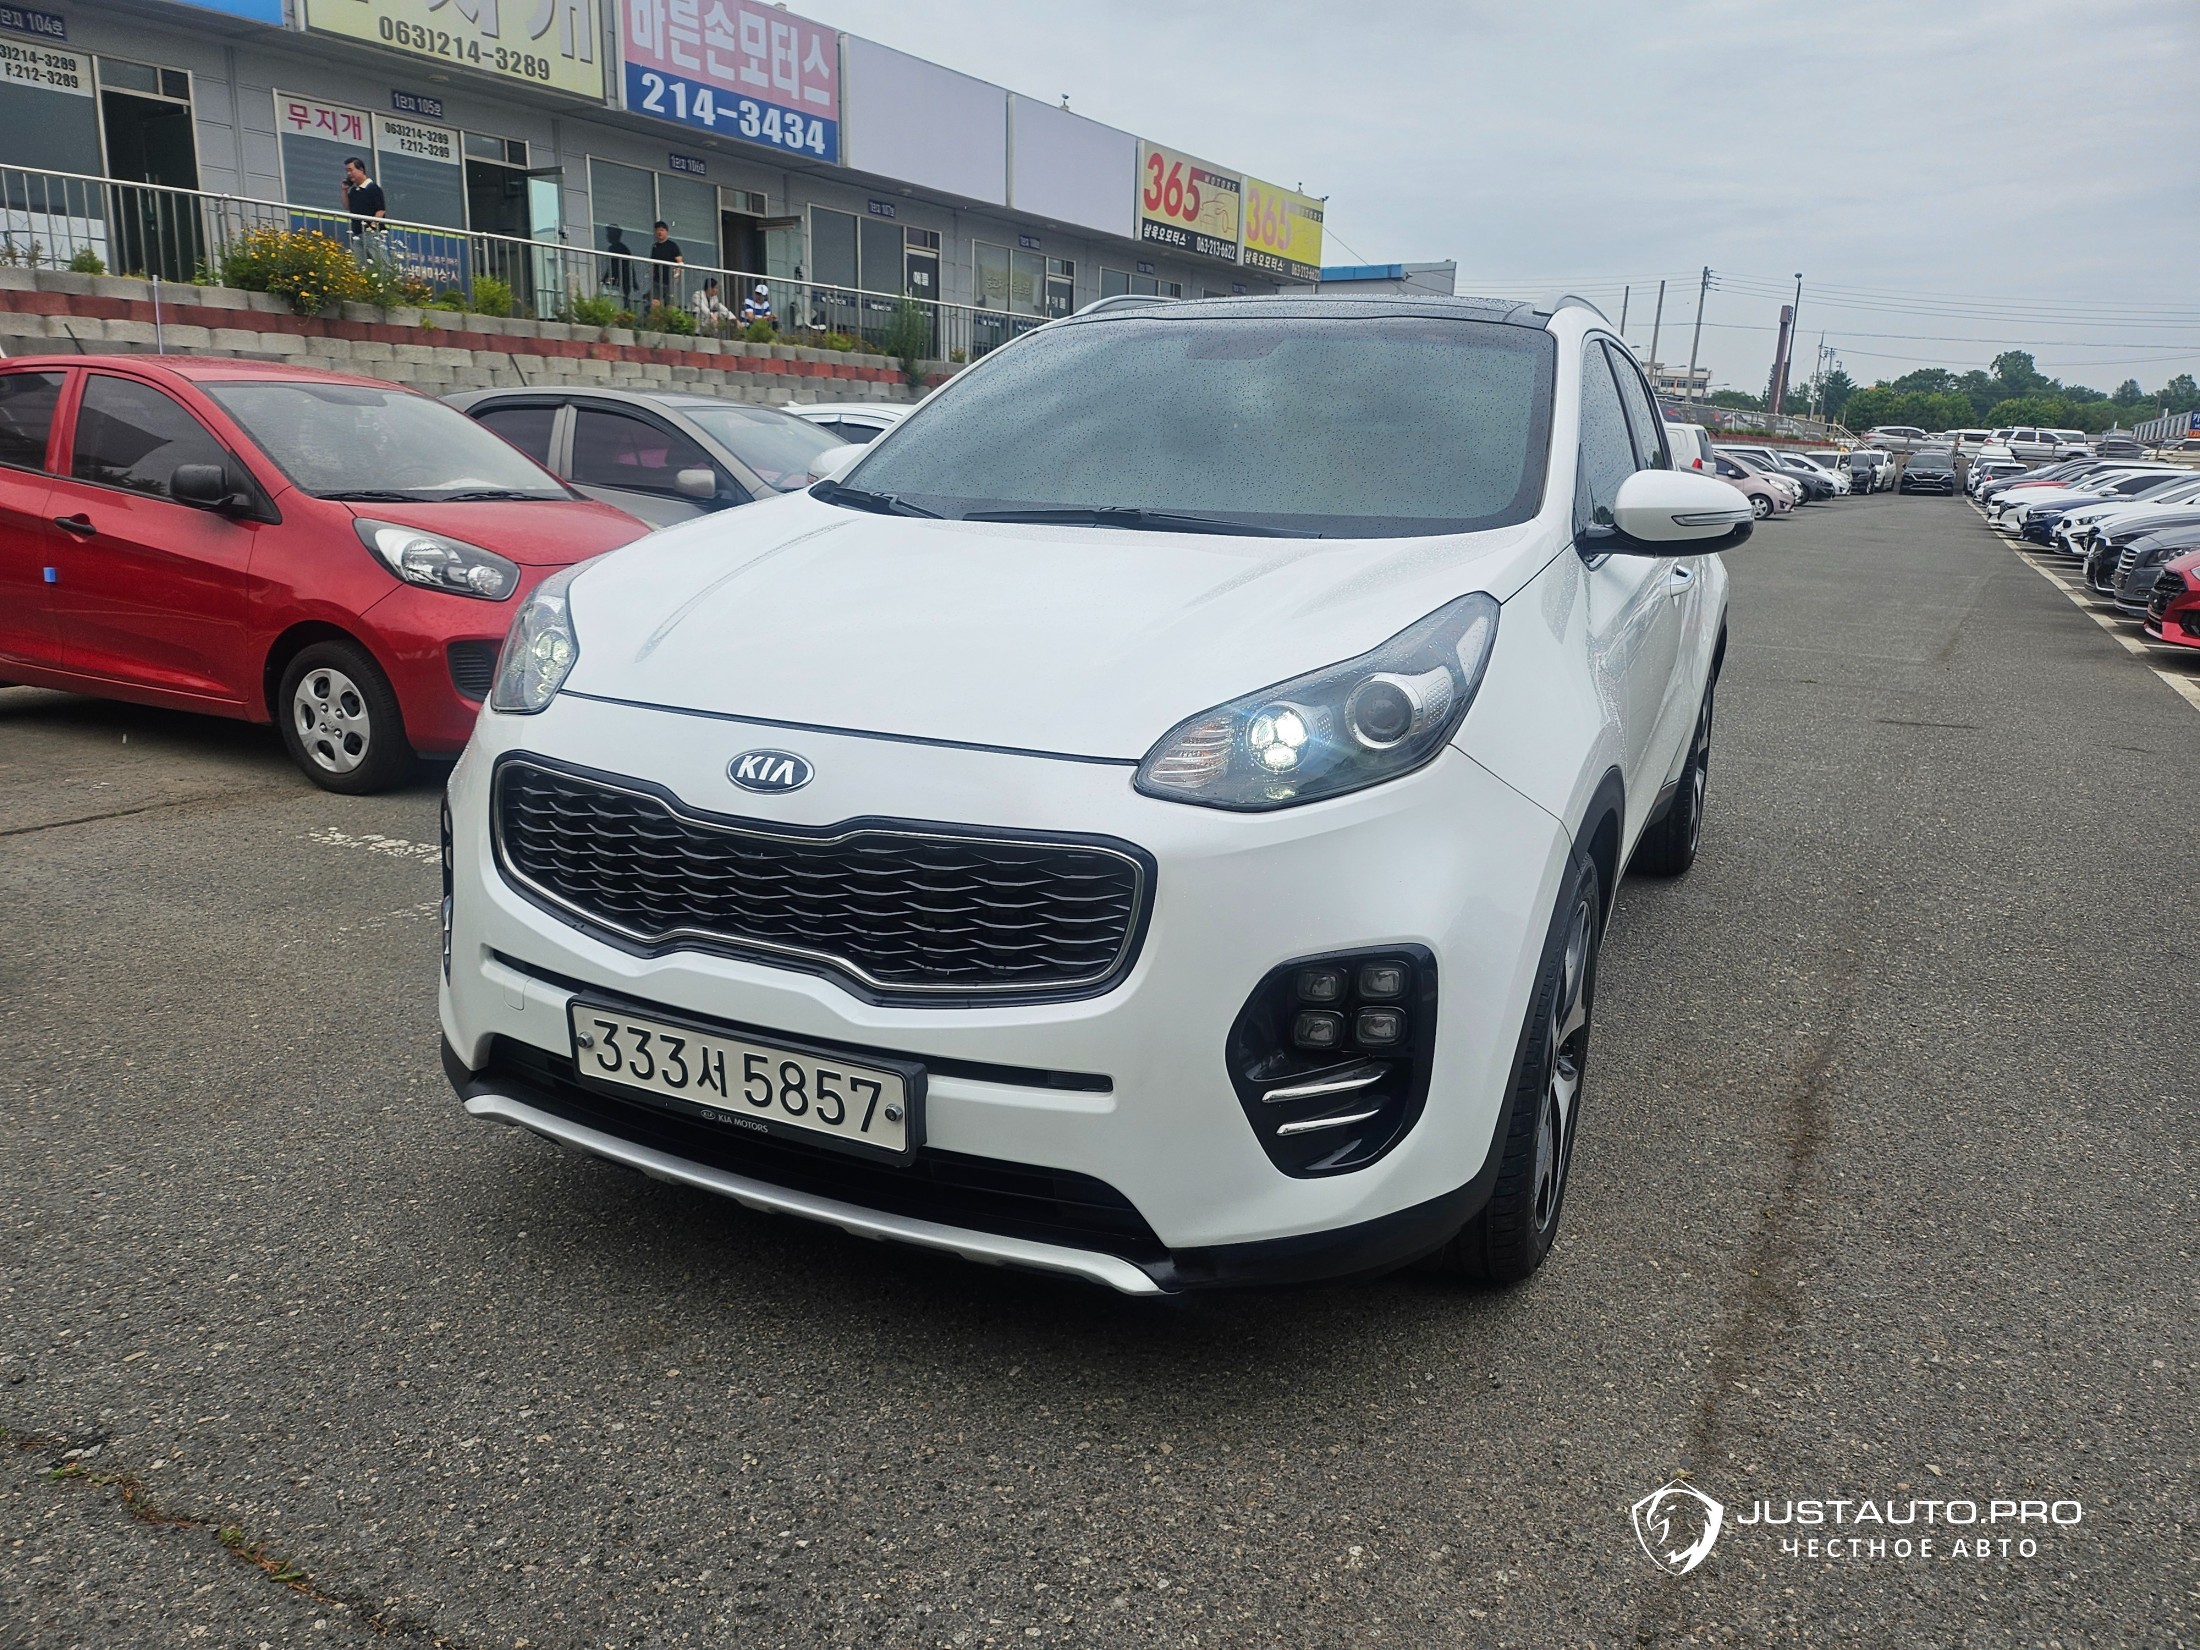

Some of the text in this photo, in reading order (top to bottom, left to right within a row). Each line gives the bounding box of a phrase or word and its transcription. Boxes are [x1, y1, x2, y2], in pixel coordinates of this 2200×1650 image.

[27, 12, 64, 37] 104호
[378, 15, 551, 81] 063)214-3289
[5, 61, 79, 89] F.212-3289
[287, 102, 362, 141] 무지개
[640, 72, 826, 155] 214-3434
[384, 121, 449, 145] 063)214-3289
[400, 138, 450, 159] F.212-3289
[1143, 152, 1237, 222] 365 MOTORS
[1246, 187, 1291, 250] 365
[1143, 222, 1236, 261] 삼육오모터스 063-213-6622
[1244, 250, 1284, 272] 삼육오모터스
[736, 755, 795, 786] KIA
[593, 1018, 883, 1133] 333서 5857
[718, 1113, 732, 1124] KIA
[734, 1118, 769, 1133] MOTORS
